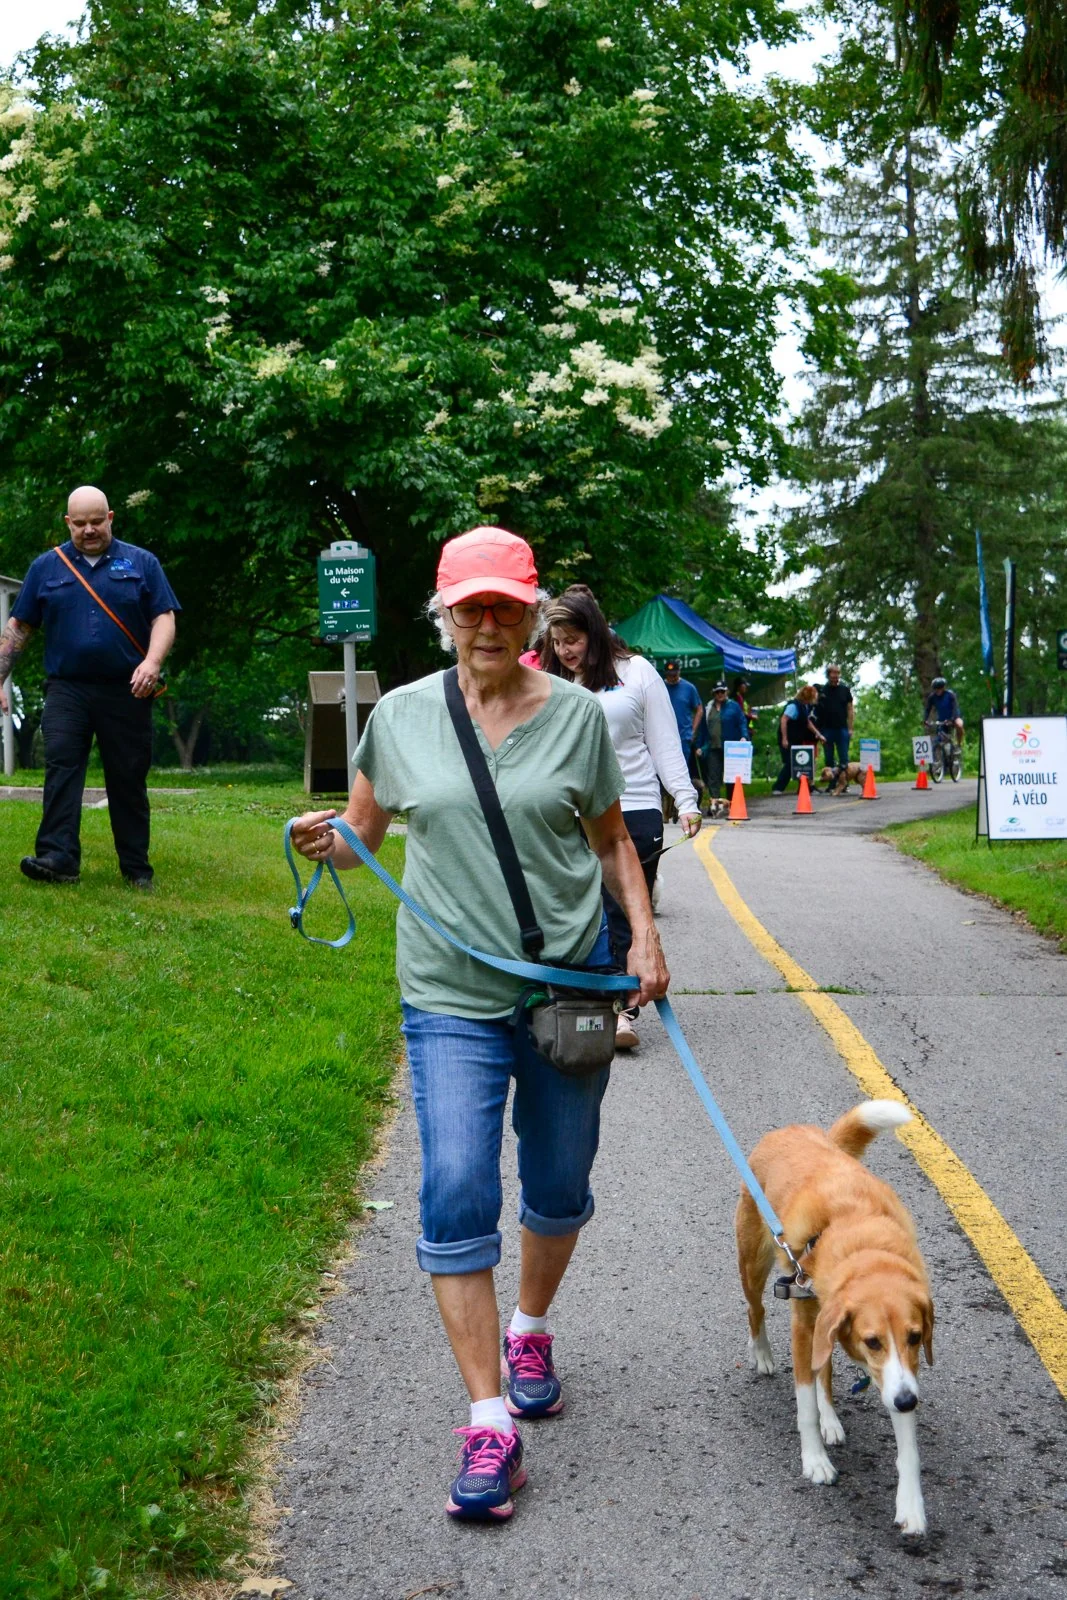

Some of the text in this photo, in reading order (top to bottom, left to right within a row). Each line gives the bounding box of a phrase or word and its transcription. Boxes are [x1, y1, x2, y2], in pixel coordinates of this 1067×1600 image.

[324, 566, 364, 576] La Maison
[330, 575, 359, 584] du vélo
[915, 741, 929, 754] 20
[1000, 772, 1058, 785] PATROUILLE
[1013, 789, 1048, 805] À VÉLO
